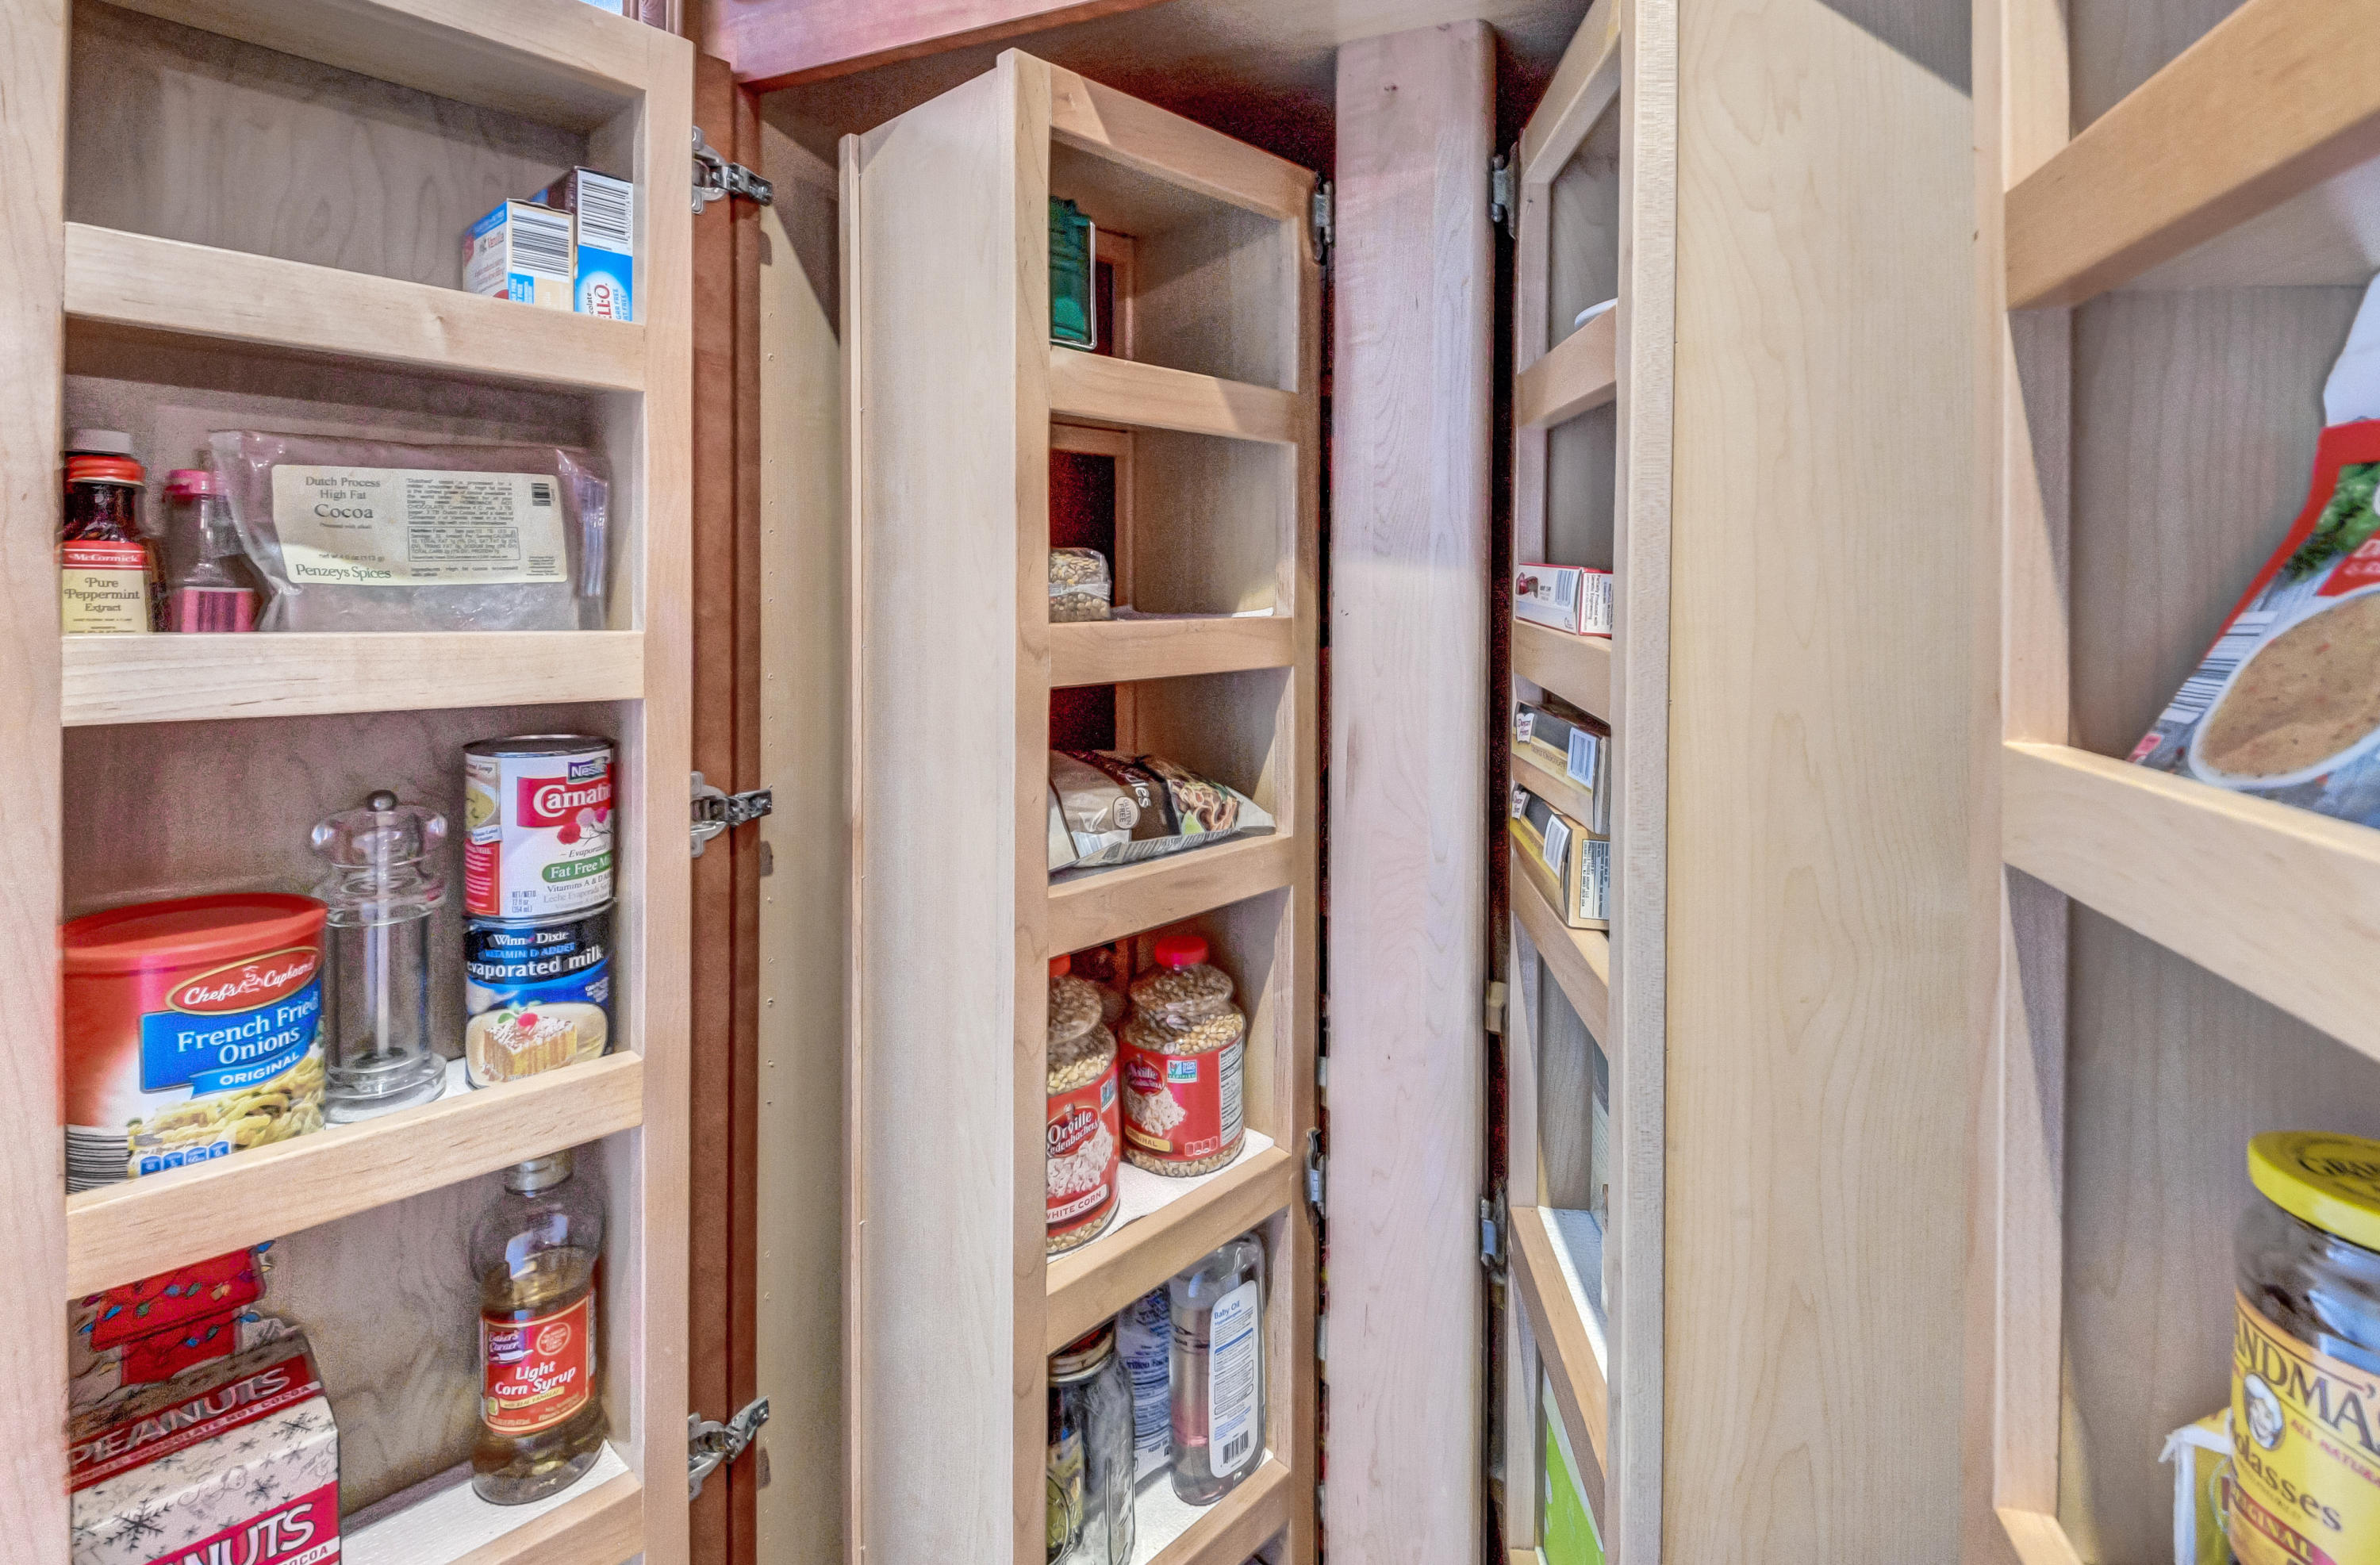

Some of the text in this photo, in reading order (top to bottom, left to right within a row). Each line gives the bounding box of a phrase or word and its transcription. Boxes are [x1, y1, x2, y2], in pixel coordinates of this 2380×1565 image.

[305, 476, 381, 488] Dutch Process
[320, 489, 367, 501] High Fat
[314, 503, 374, 519] Cocoa
[68, 553, 139, 562] McCormick
[295, 563, 392, 581] Penzeys Spices
[85, 577, 119, 588] Pure
[63, 589, 140, 602] Peppermint
[85, 603, 122, 613] Extract
[551, 866, 571, 880] Fat
[574, 862, 598, 876] Free
[547, 882, 583, 893] Vitamins
[493, 931, 570, 946] Winn Dixie
[466, 945, 605, 980] evaporated milk
[184, 984, 238, 1005] Chef's
[177, 991, 319, 1053] French Fried
[218, 1026, 301, 1065] Onions
[219, 1052, 301, 1086] ORIGINAL
[1048, 1110, 1092, 1145] Orville
[1077, 1190, 1102, 1210] CORN
[1214, 1300, 1240, 1320] Baby Oil
[495, 1366, 577, 1395] Corn Syrup
[515, 1360, 556, 1382] Light
[261, 1385, 309, 1408] COCOA
[70, 1367, 290, 1465] PEANUTS
